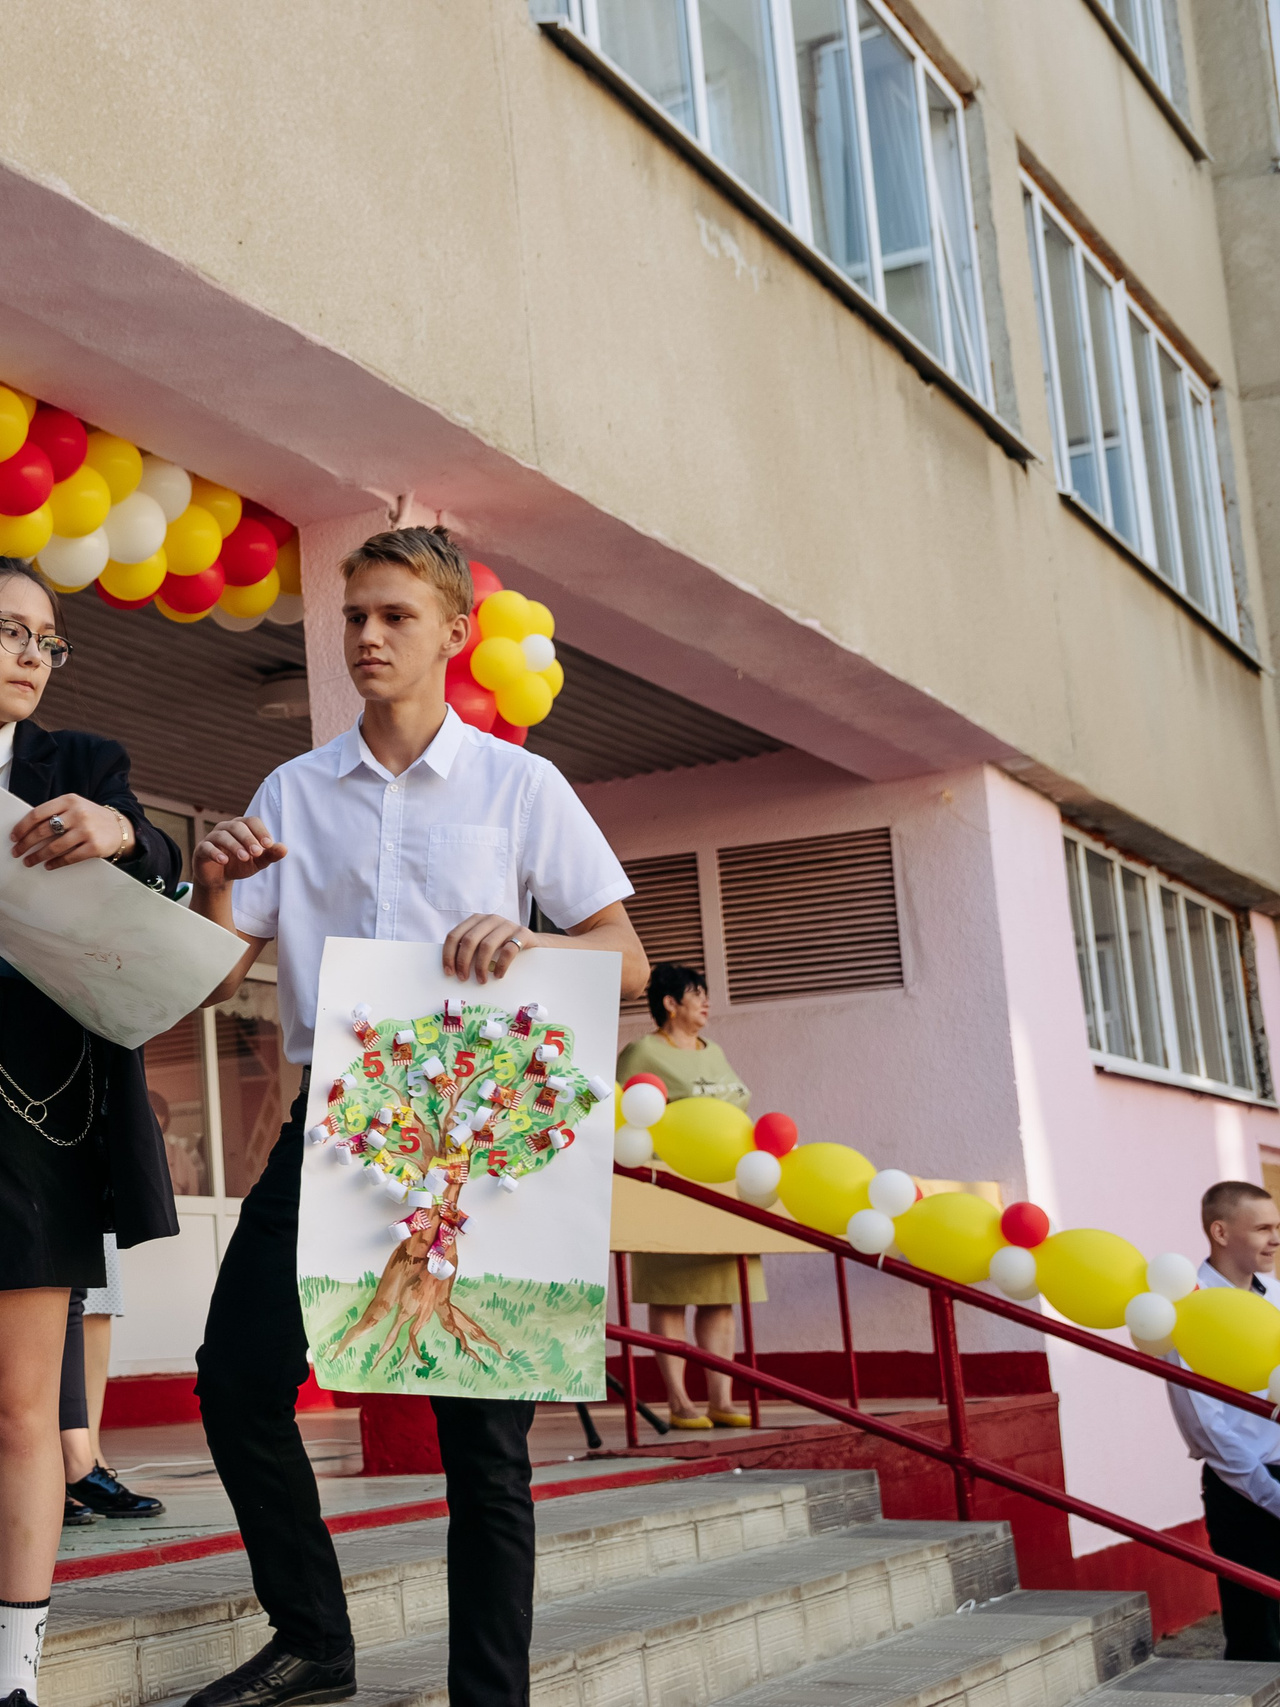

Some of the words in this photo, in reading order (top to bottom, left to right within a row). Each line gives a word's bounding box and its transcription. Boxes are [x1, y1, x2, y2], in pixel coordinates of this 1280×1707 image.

[415, 1016, 439, 1044] 5
[363, 1051, 385, 1078] 5
[452, 1051, 476, 1077] 5
[493, 1052, 516, 1080] 5
[407, 1070, 429, 1097] 5
[345, 1104, 367, 1132] 5
[453, 1099, 476, 1127] 5
[509, 1104, 532, 1132] 5
[398, 1127, 420, 1153] 5
[487, 1150, 508, 1177] 5
